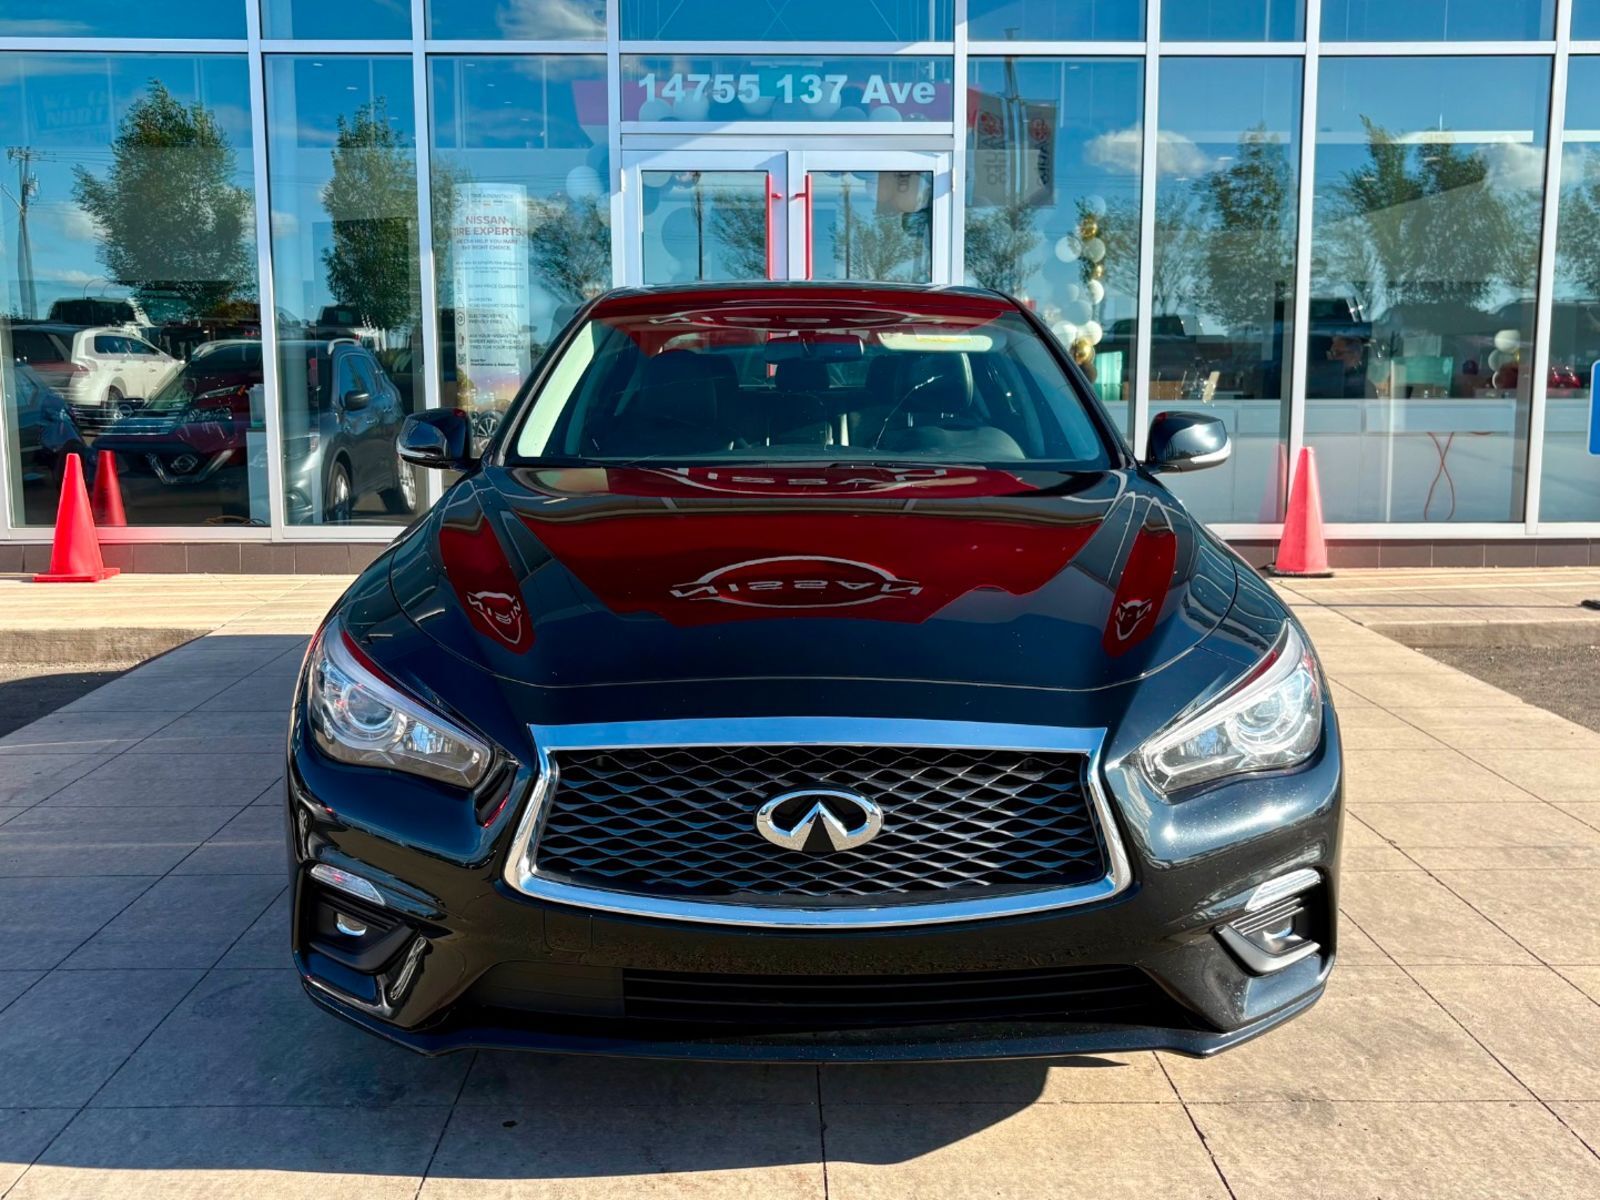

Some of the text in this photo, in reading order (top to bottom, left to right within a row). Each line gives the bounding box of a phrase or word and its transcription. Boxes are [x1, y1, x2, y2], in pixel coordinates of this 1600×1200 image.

[638, 73, 936, 104] 14755 137 Ave
[465, 215, 506, 225] NISSAN
